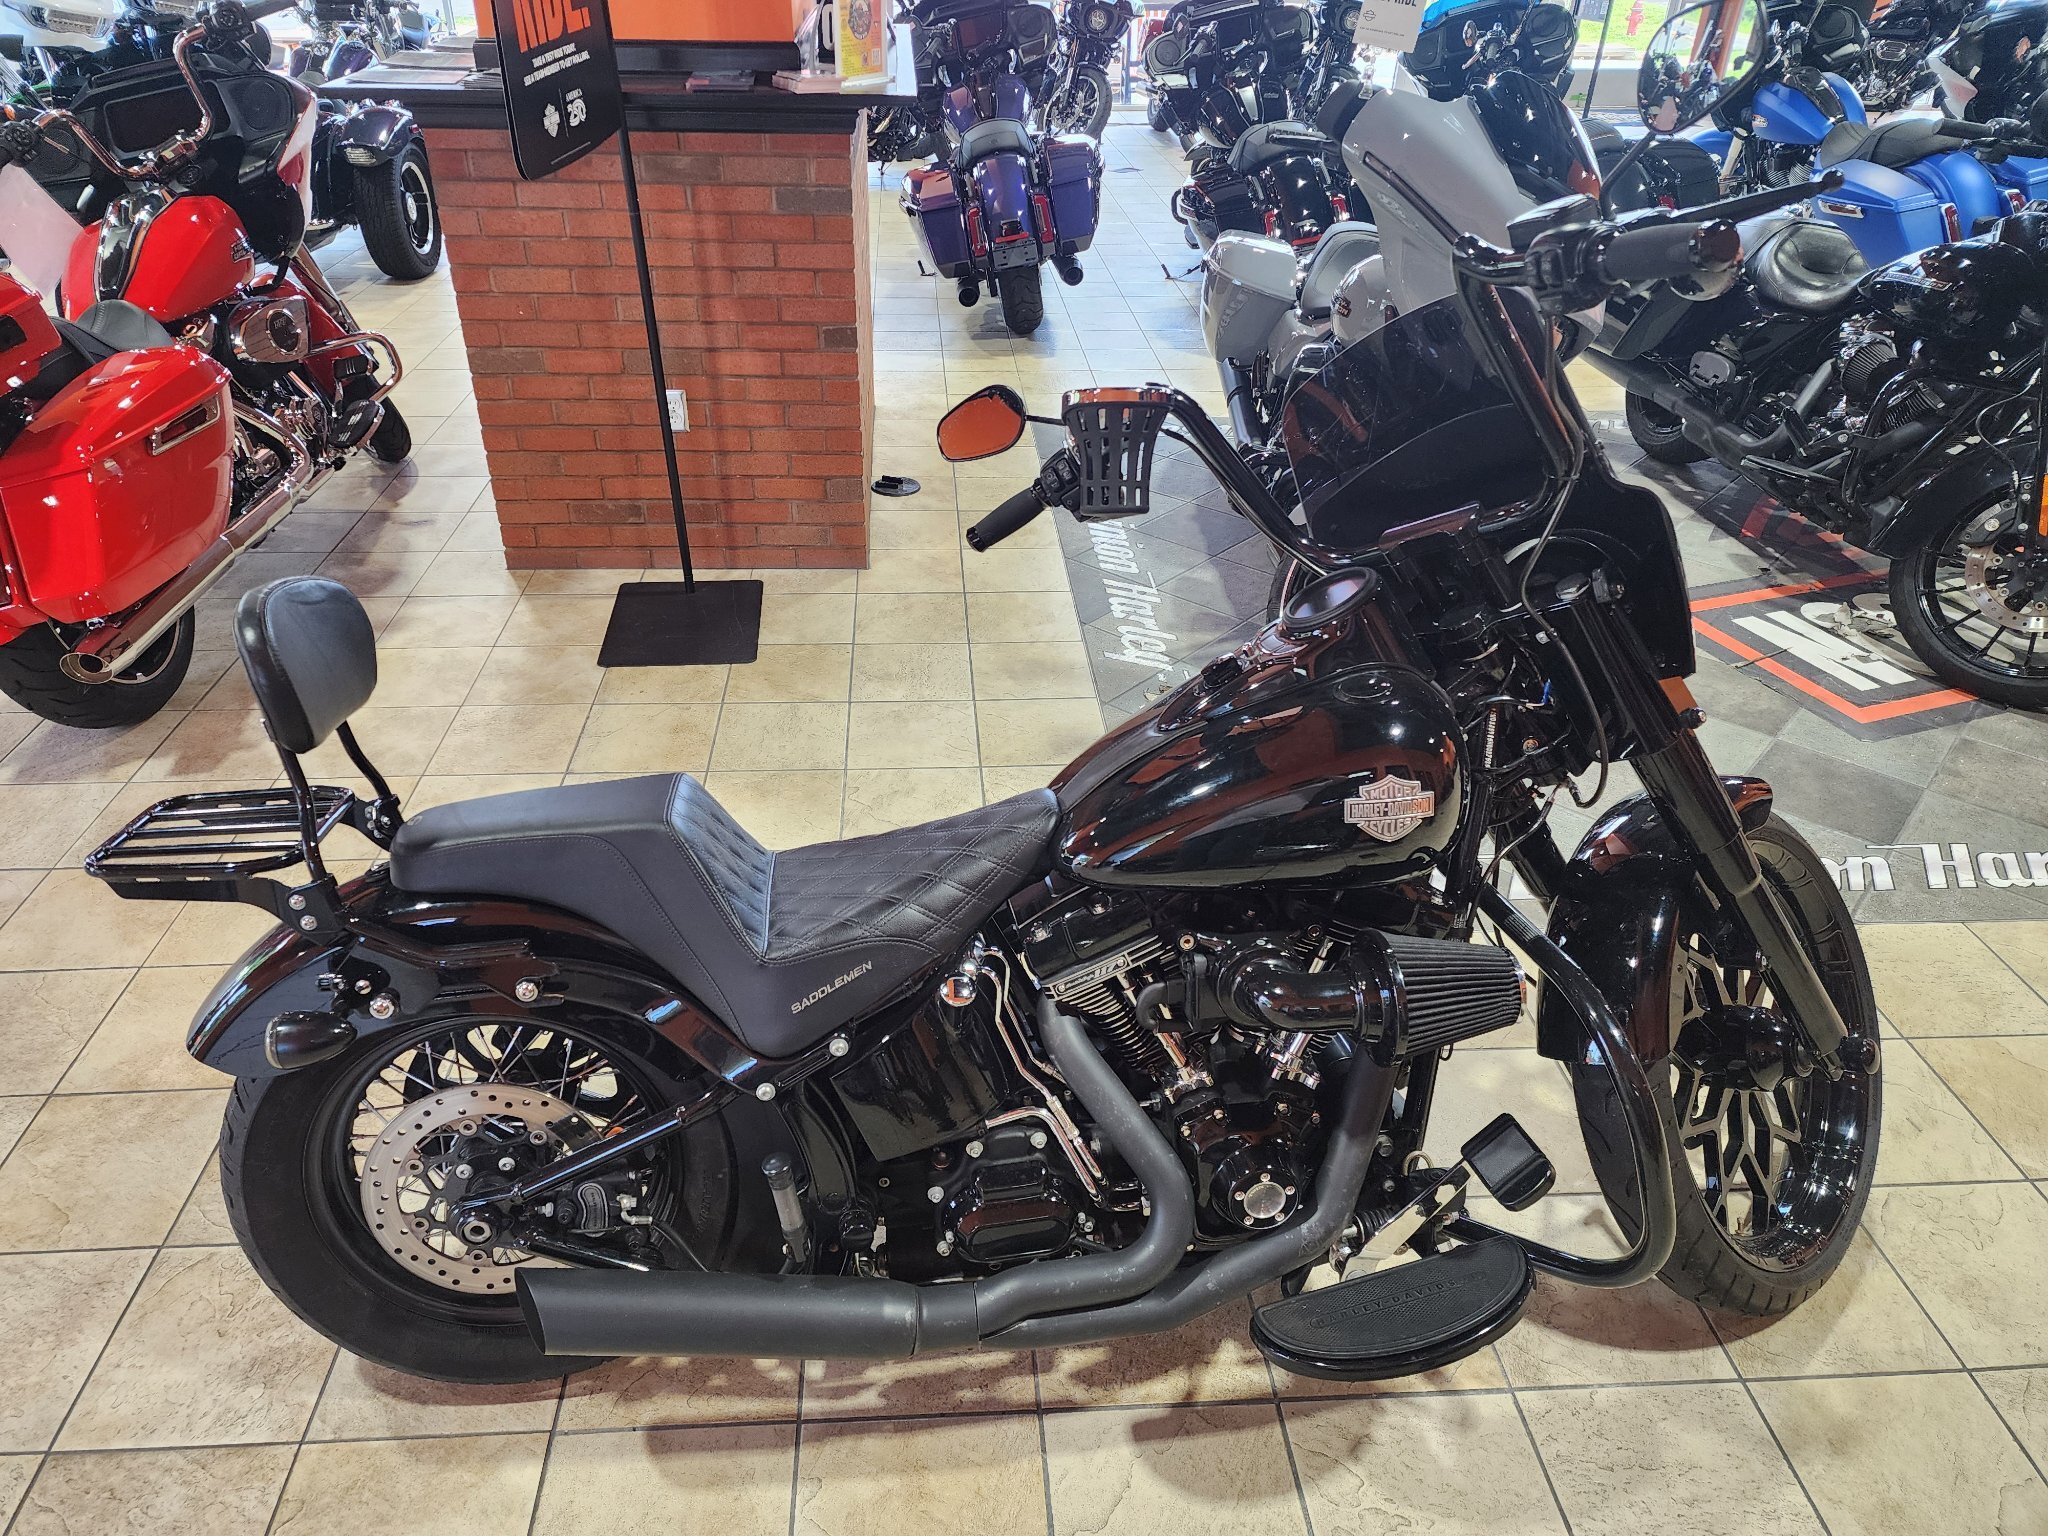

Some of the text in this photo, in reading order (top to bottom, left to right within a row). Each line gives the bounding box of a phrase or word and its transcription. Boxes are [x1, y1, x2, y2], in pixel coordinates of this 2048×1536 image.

[1101, 570, 1178, 672] Harley
[1351, 797, 1431, 818] HARLEY-DAVIDSON
[1370, 784, 1413, 800] MOTOR
[1369, 817, 1412, 837] CYCLES
[790, 960, 873, 1015] SADDLEMEN
[1315, 1268, 1487, 1328] HARLEY-DAVIDS
